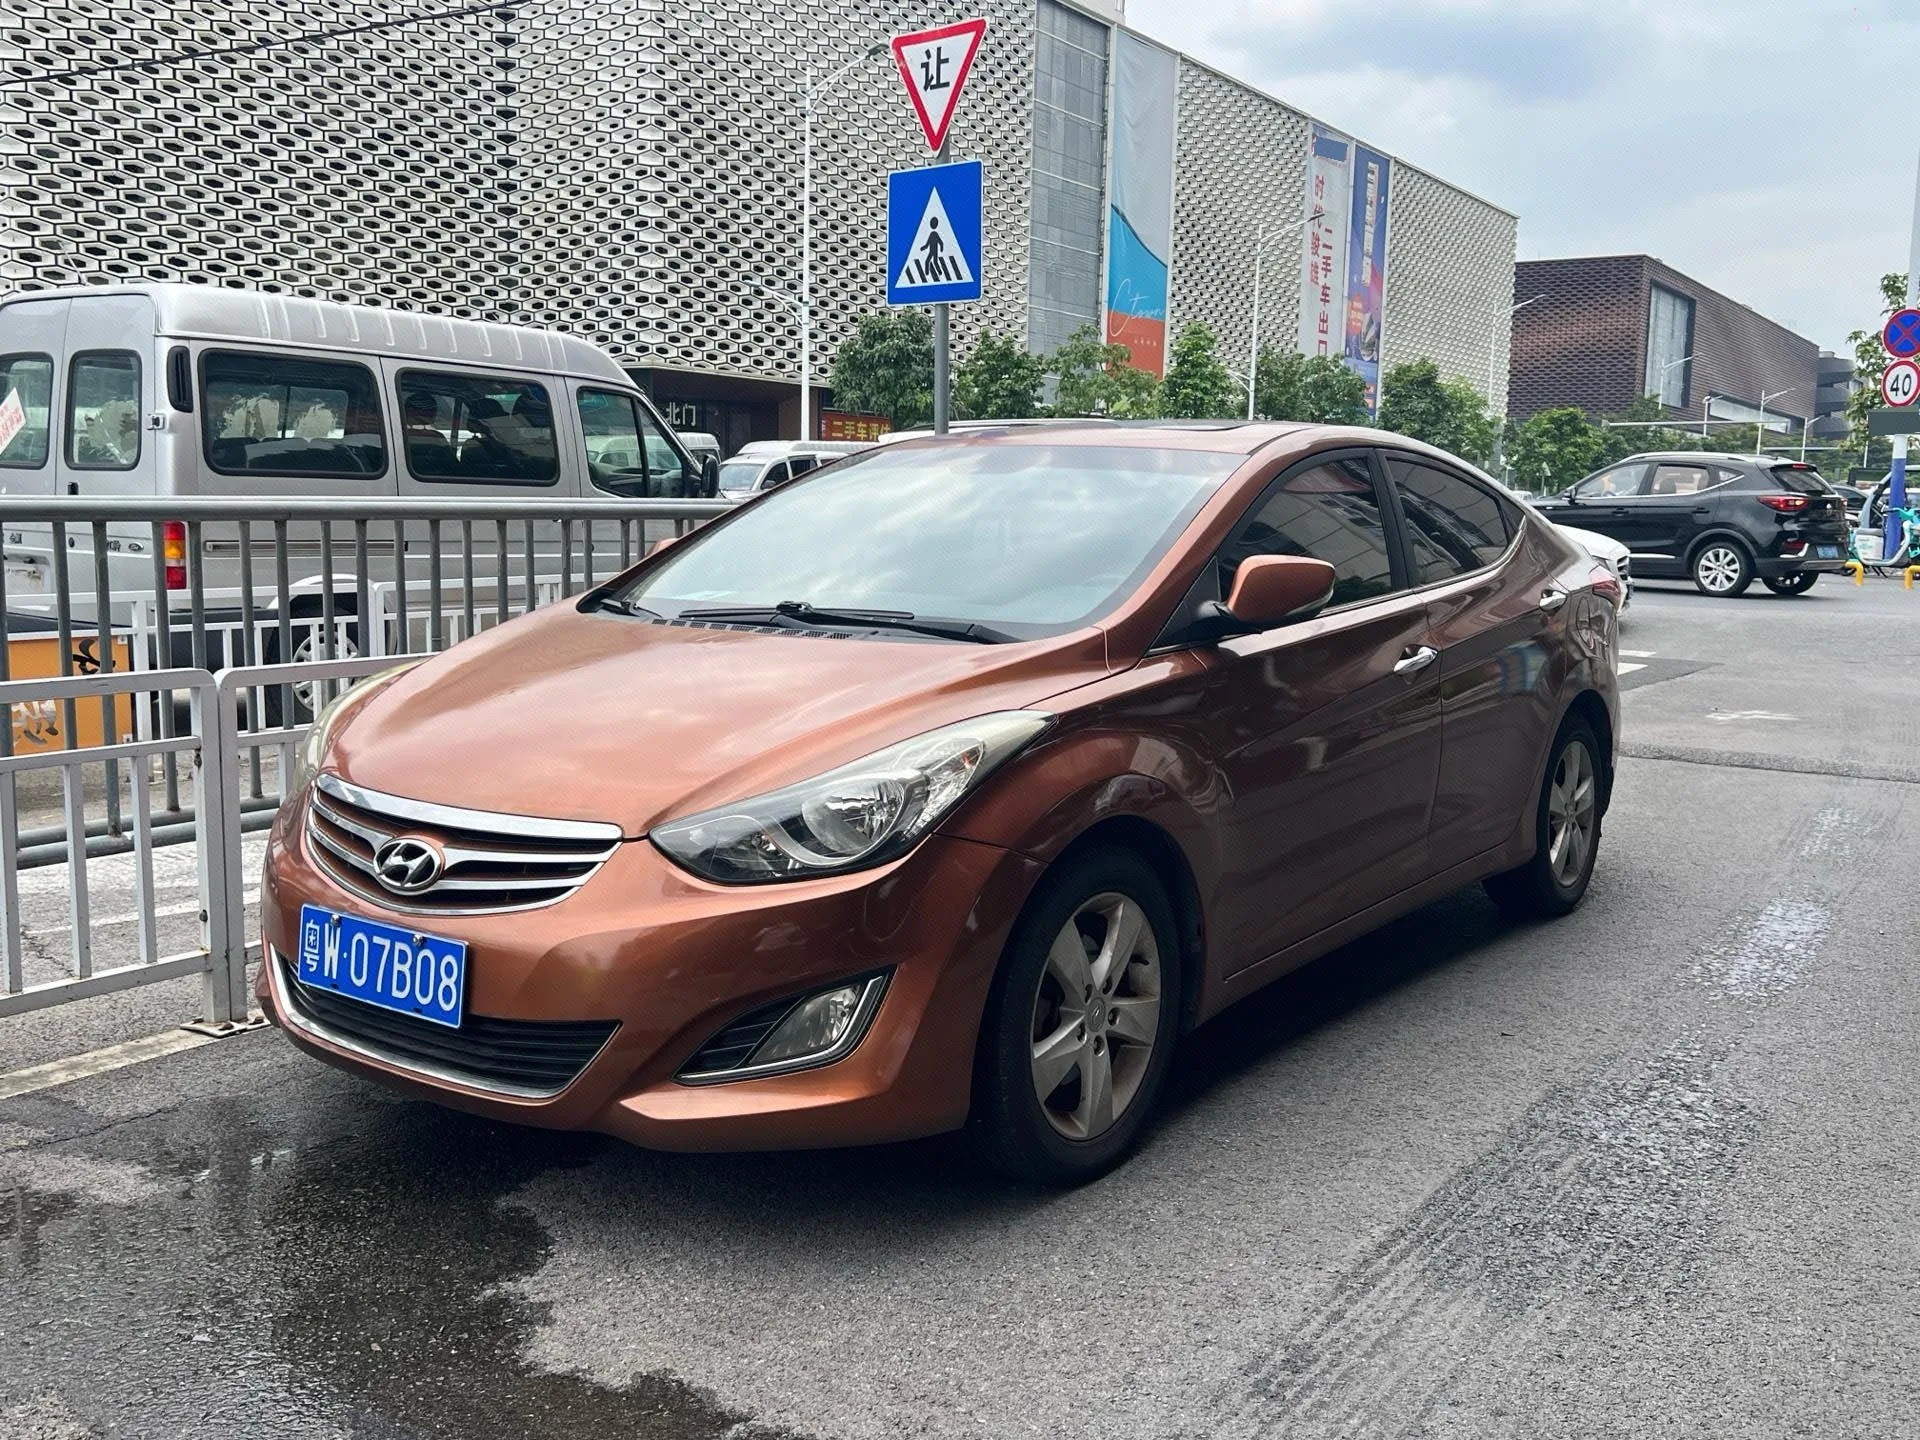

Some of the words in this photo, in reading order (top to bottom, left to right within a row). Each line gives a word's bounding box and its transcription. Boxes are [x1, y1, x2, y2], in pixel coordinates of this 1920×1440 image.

[920, 46, 950, 92] 让
[1318, 227, 1333, 356] 二手车出口
[1889, 372, 1912, 397] 40
[665, 402, 696, 427] 北门
